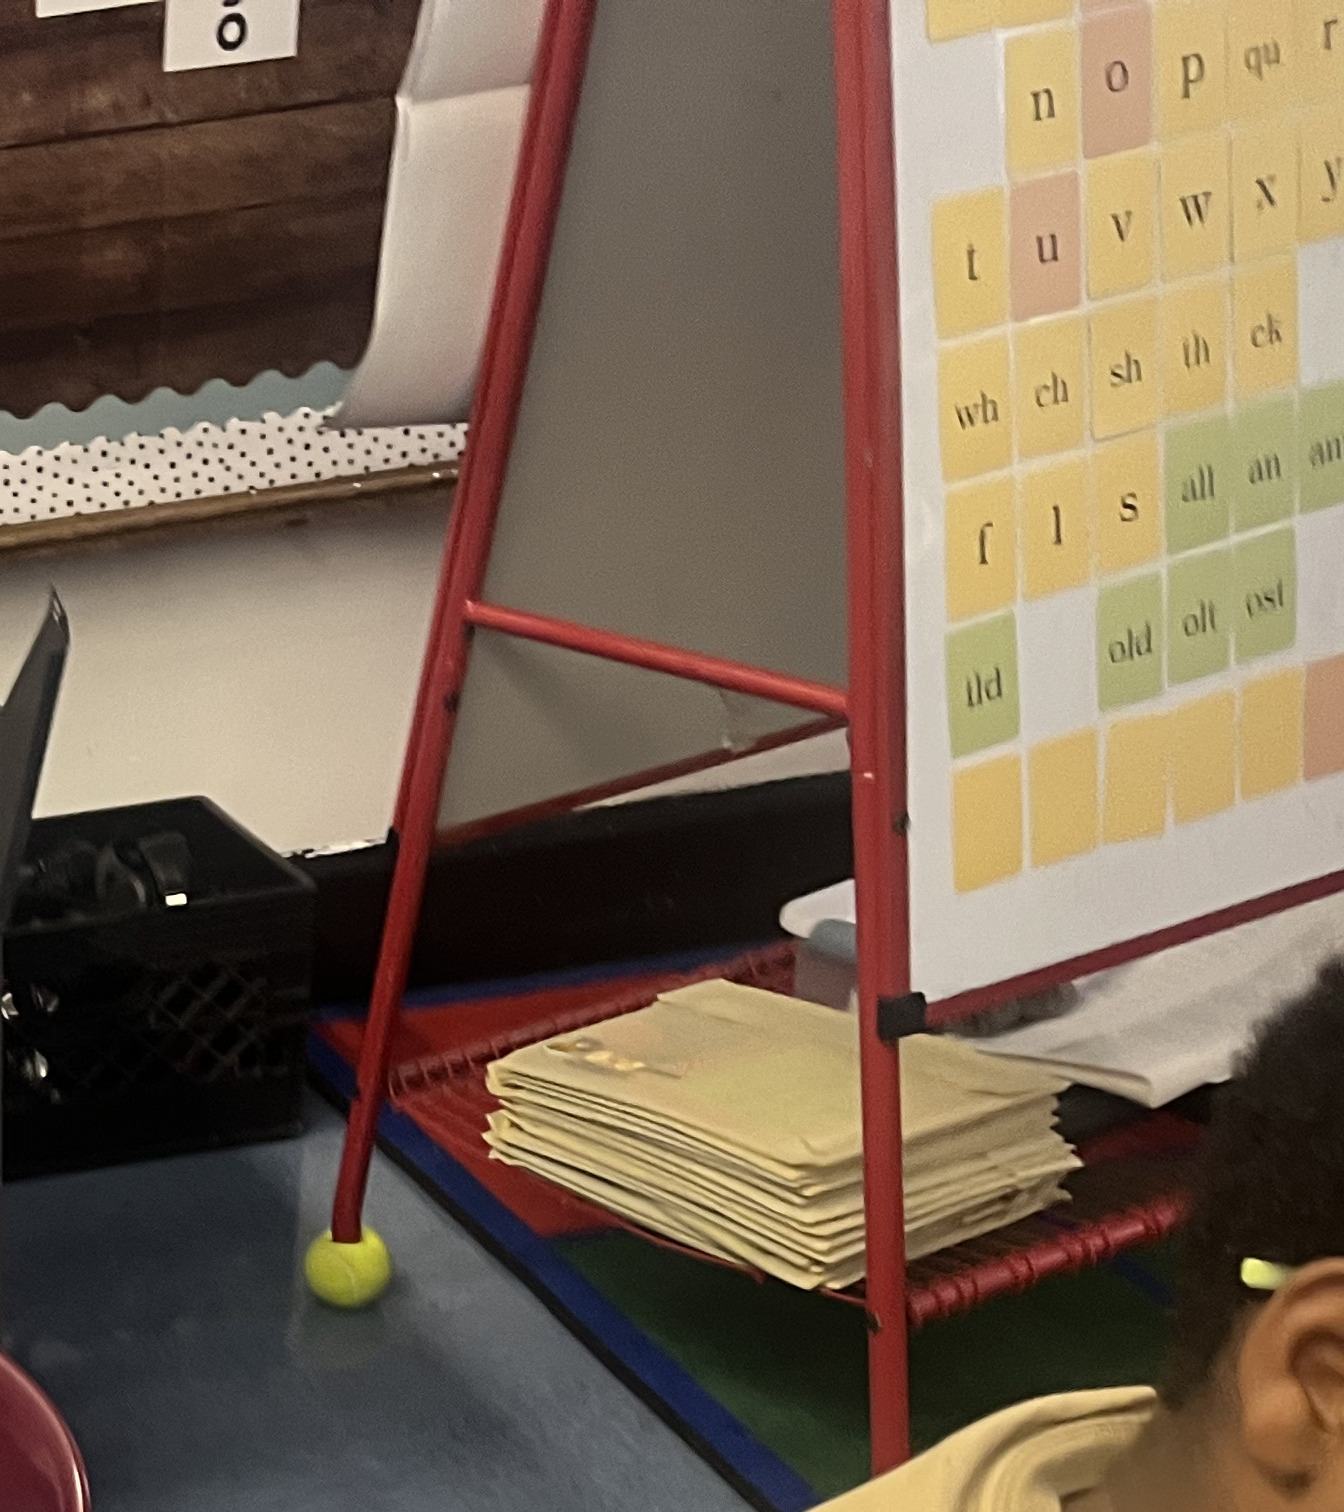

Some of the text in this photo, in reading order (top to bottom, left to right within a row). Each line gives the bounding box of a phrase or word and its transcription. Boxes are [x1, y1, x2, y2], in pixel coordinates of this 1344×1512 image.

[1030, 19, 1339, 122] n o p qu r
[1036, 233, 1059, 265] u
[1110, 209, 1133, 242] v
[1179, 191, 1213, 229] w
[1255, 173, 1277, 216] x
[1320, 156, 1343, 204] y
[955, 313, 1284, 431] wh ch sh th ck
[1118, 491, 1140, 523] s
[1181, 464, 1217, 504] all
[1248, 453, 1283, 485] an
[966, 666, 1004, 708] ild
[1108, 622, 1154, 664] old
